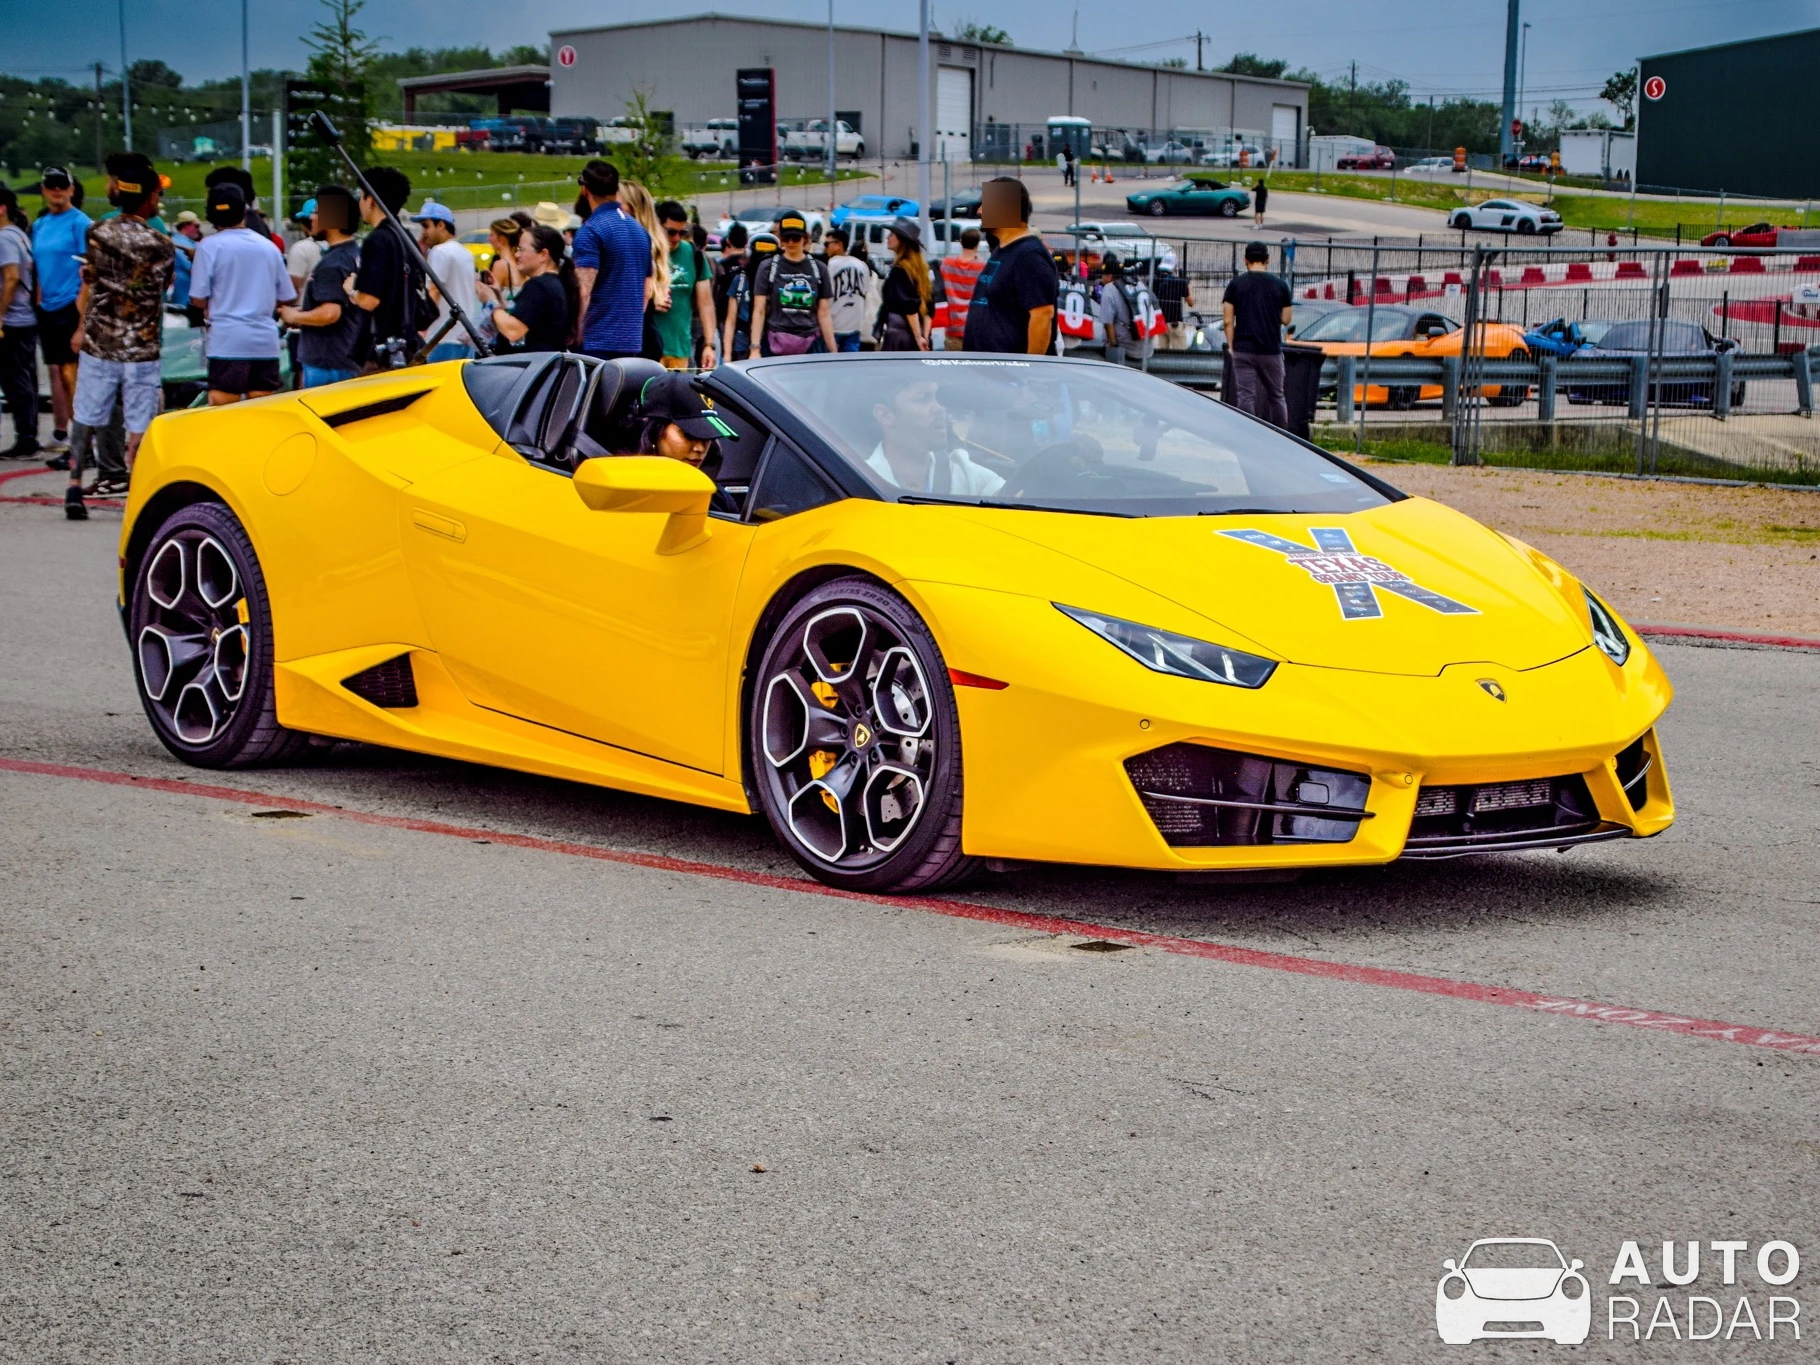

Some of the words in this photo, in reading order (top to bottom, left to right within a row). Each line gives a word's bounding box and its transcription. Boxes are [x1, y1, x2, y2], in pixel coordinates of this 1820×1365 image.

[1288, 557, 1392, 573] TEXAS
[1312, 572, 1369, 583] GRAND
[1364, 571, 1410, 581] TOUR
